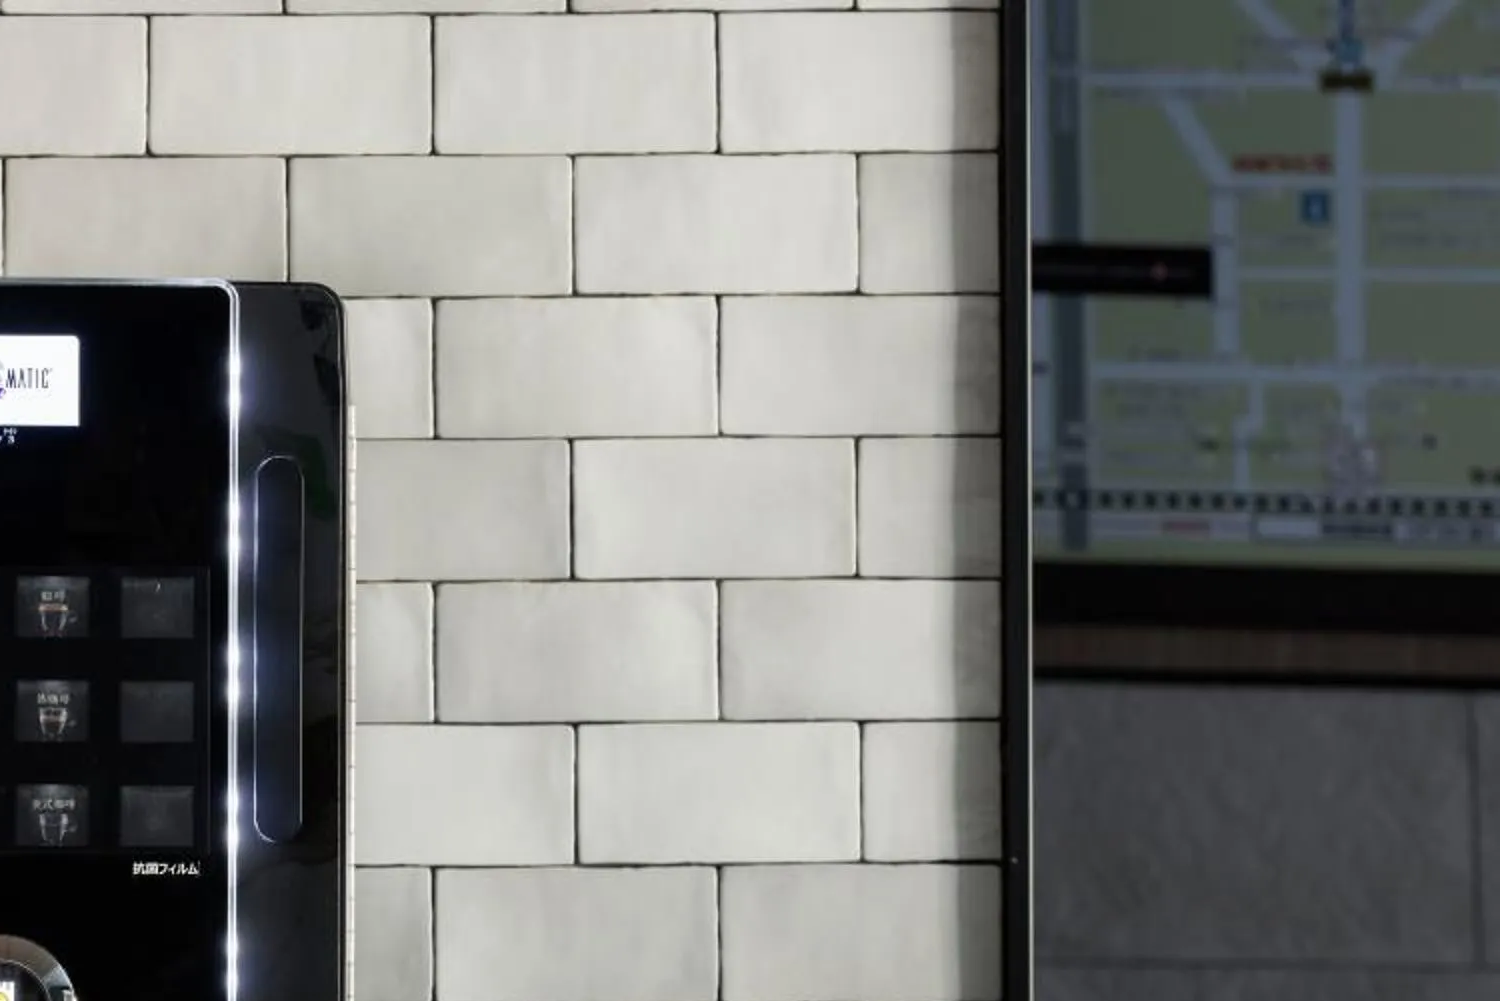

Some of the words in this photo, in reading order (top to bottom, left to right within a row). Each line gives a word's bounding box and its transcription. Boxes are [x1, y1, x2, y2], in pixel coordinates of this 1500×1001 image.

[5, 367, 52, 389] MATIC
[132, 860, 199, 875] 抗菌フィルム
